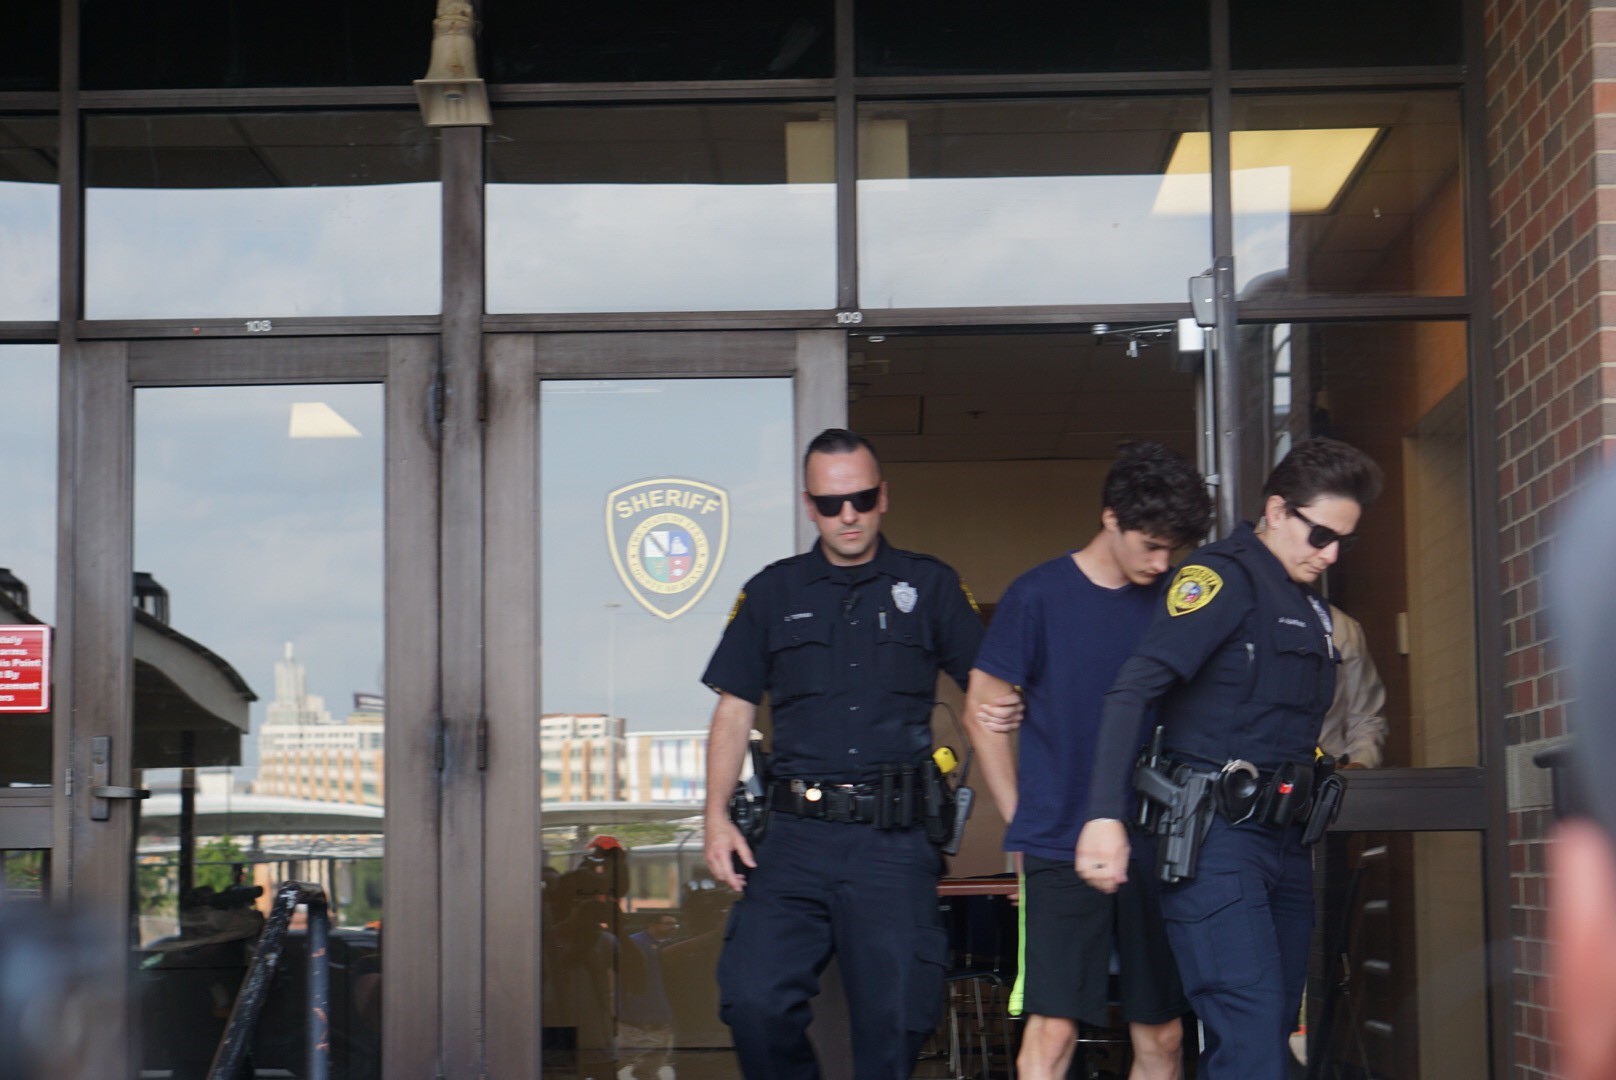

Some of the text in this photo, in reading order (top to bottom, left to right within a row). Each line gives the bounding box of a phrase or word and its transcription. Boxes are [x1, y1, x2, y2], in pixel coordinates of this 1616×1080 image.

[835, 312, 862, 324] 109
[615, 489, 720, 518] SHERIFF
[11, 659, 42, 667] Point
